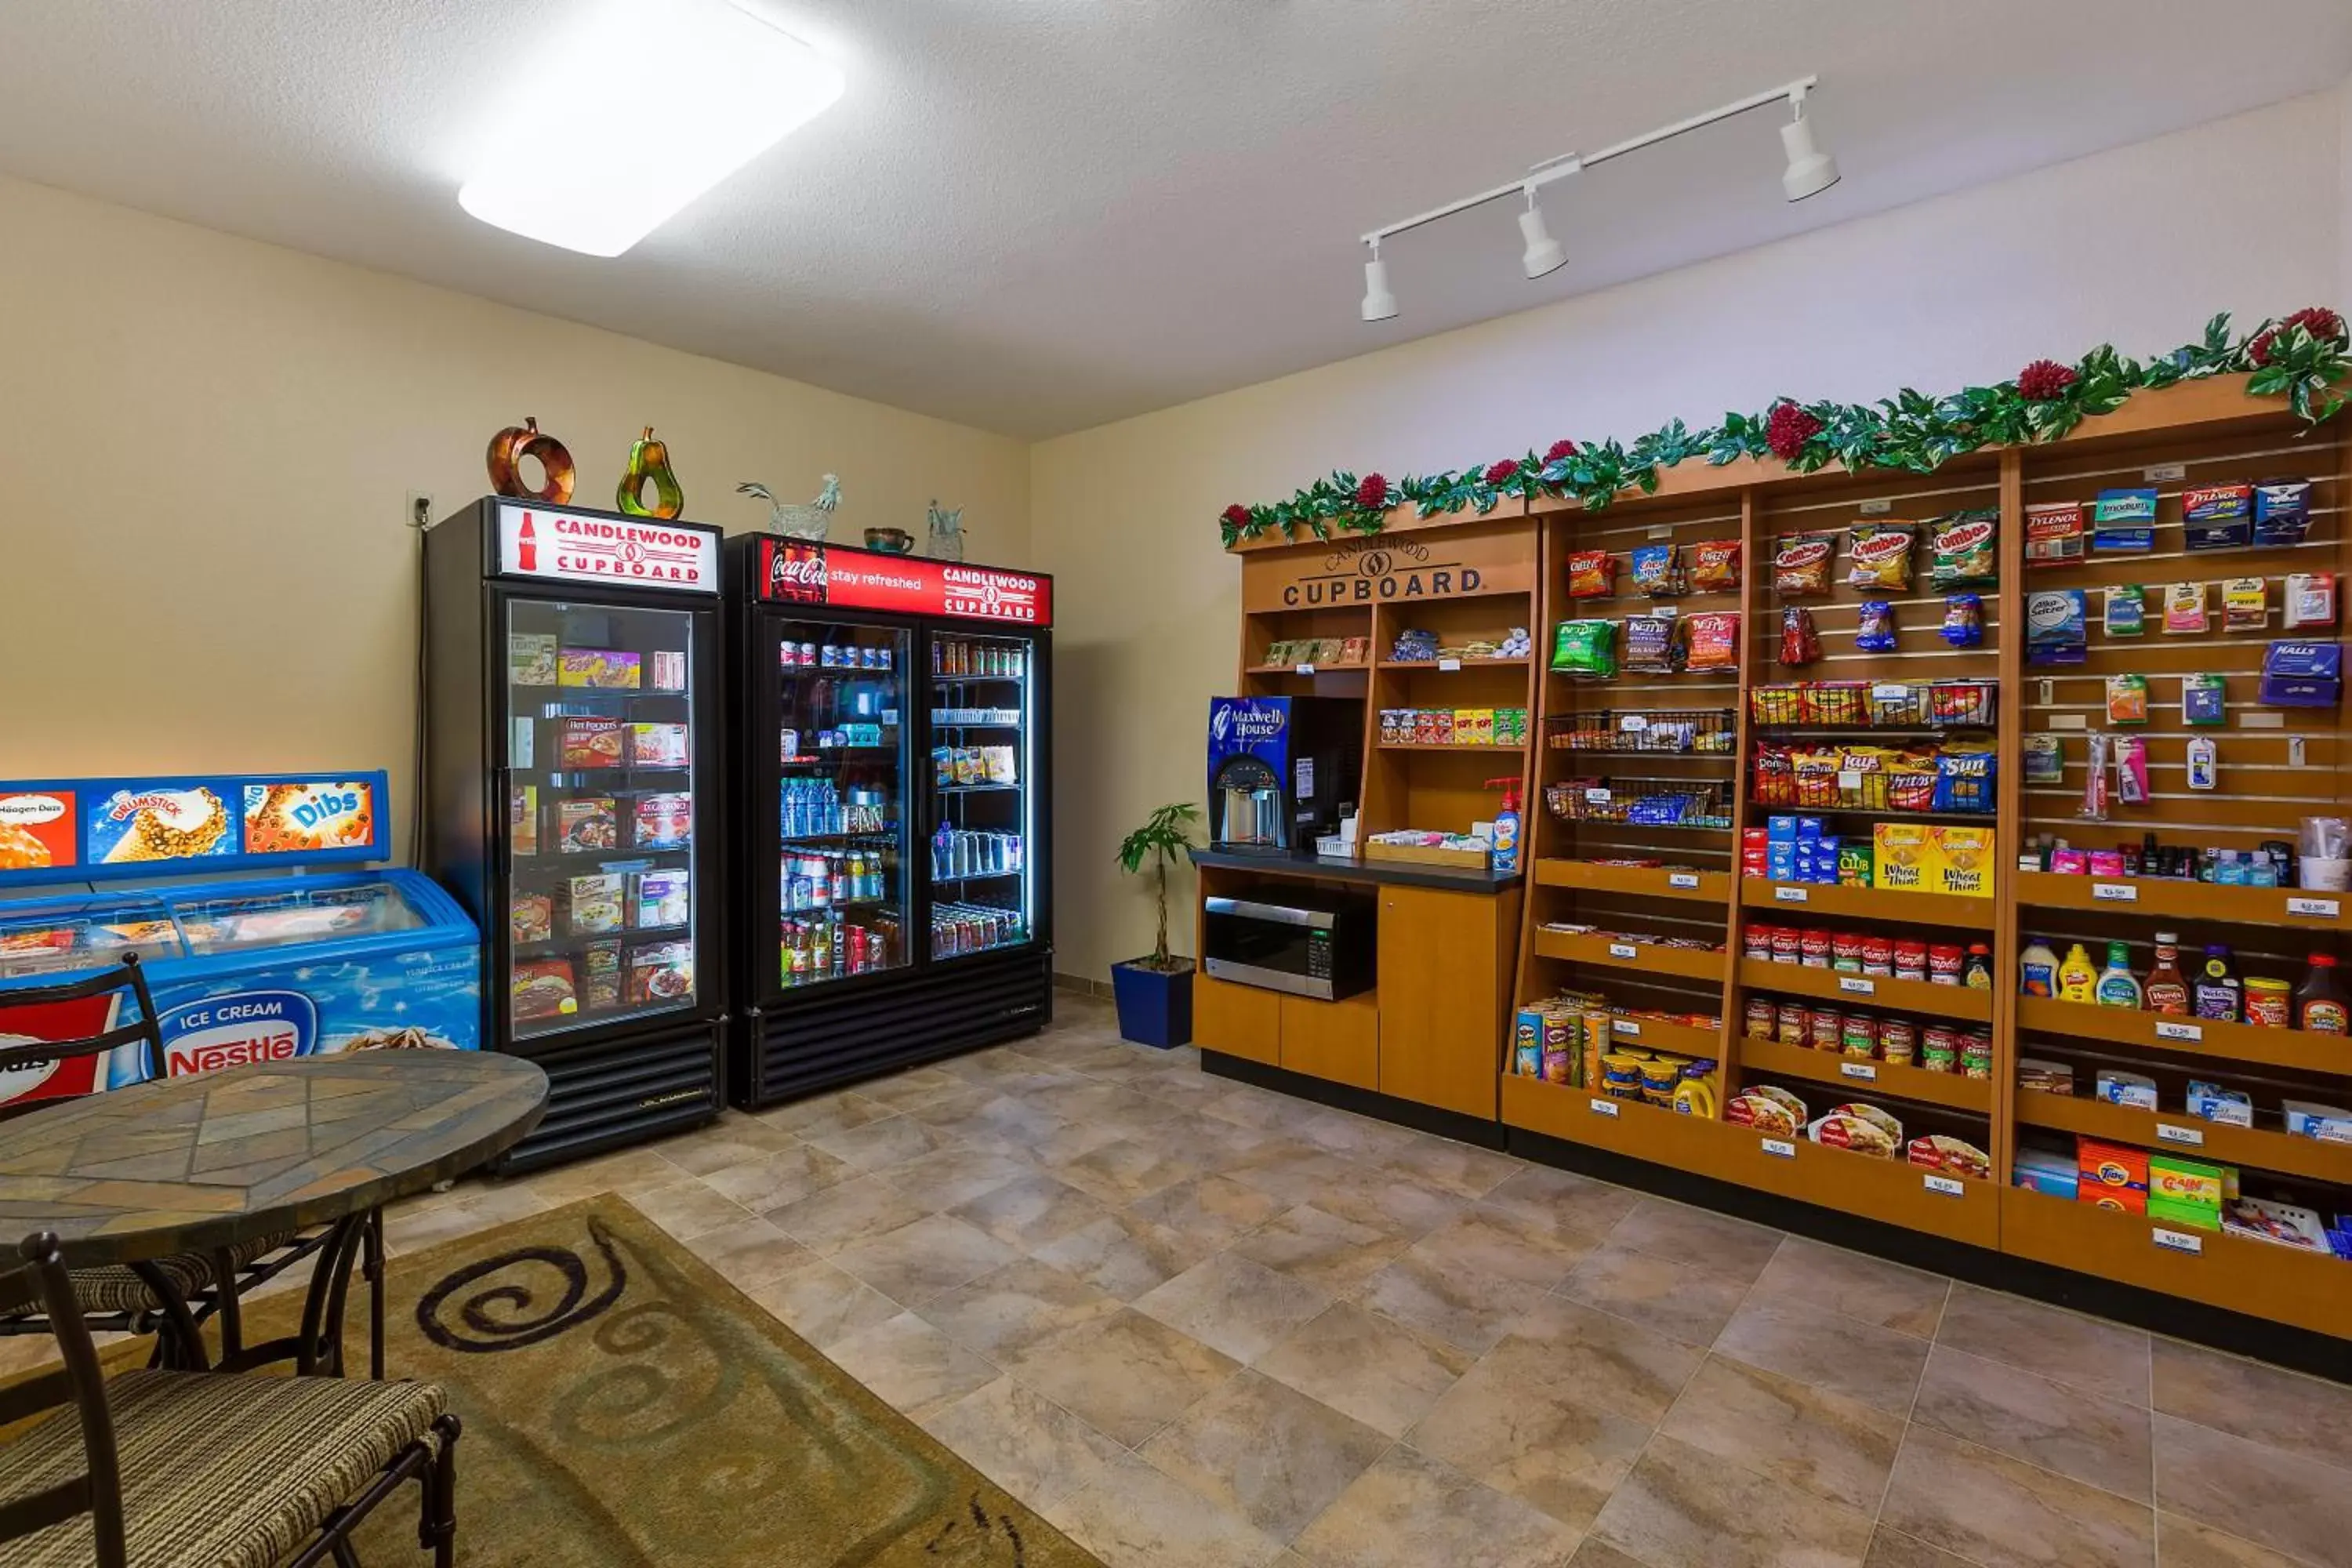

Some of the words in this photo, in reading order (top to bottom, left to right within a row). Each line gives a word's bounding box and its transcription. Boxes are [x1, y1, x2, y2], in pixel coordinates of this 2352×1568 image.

[2190, 489, 2240, 503] TYLENOL
[2028, 514, 2078, 527] TYLENOL
[555, 519, 702, 550] CANDLEWOOD
[1324, 535, 1430, 572] CANDLEWOOD
[1855, 535, 1906, 557] Combos
[557, 555, 699, 581] CUPBOARD
[772, 554, 829, 586] Coca-Cola
[831, 570, 858, 585] stay
[862, 572, 922, 590] refreshed
[943, 568, 1037, 592] CANDLEWOOD
[1283, 569, 1481, 607] CUPBOARD
[944, 598, 1035, 620] CUPBOARD
[2275, 645, 2318, 655] HALLS
[1232, 709, 1280, 724] Maxwell
[1236, 722, 1274, 736] House
[1947, 757, 1986, 775] Sun
[112, 796, 183, 821] DRUMSTICK
[291, 792, 358, 829] Dibs
[1839, 856, 1869, 872] CLUB
[1883, 863, 1920, 877] Wheat
[1883, 874, 1920, 887] Thins
[1944, 868, 1981, 881] Wheat
[1943, 880, 1981, 892] Thins
[180, 1011, 211, 1029] ICE
[216, 1000, 283, 1022] CREAM
[2101, 1166, 2125, 1181] Tide
